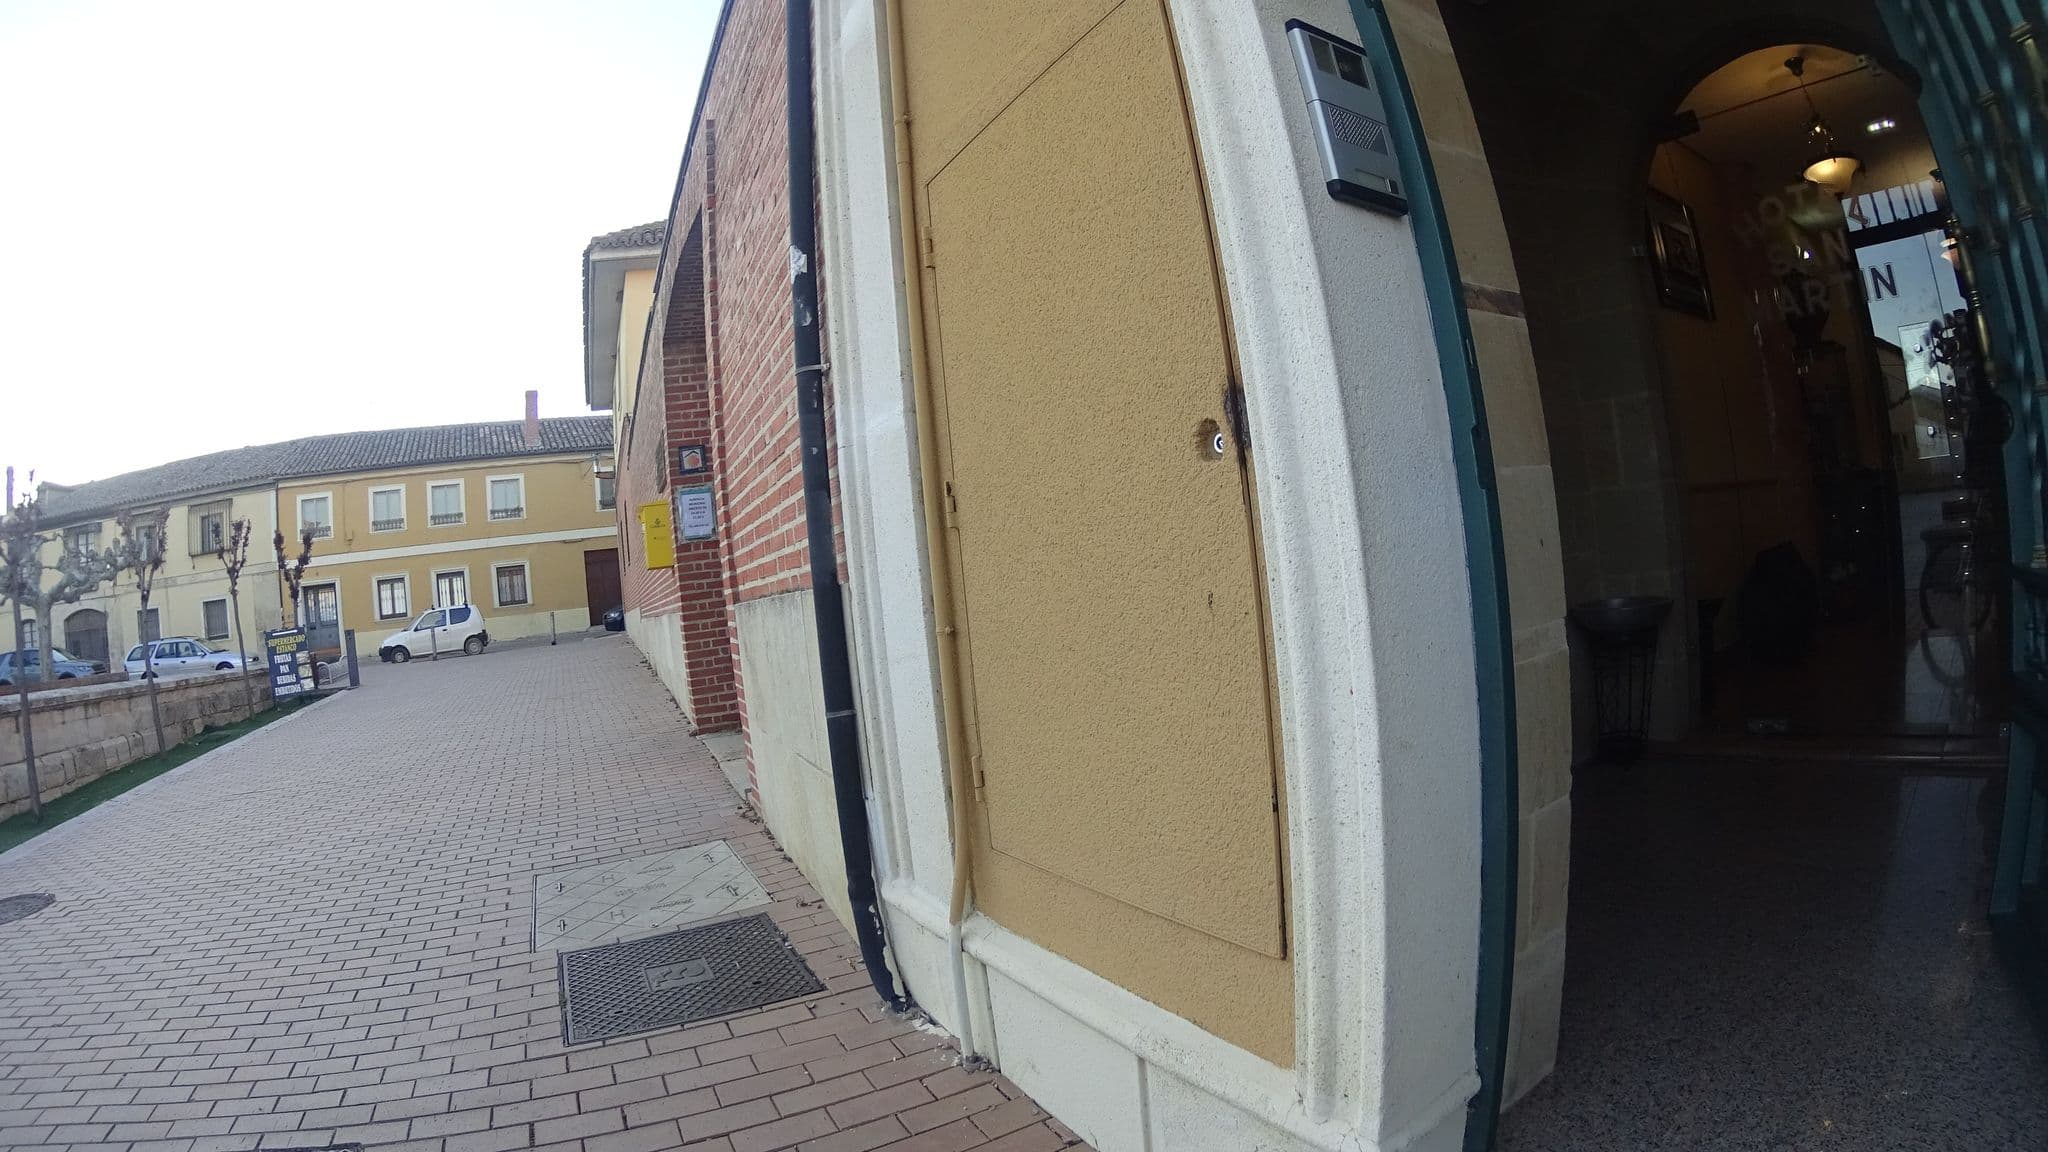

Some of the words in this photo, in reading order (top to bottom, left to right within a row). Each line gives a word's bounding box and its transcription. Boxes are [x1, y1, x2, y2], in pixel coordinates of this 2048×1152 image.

[267, 634, 306, 647] SUPERMERCADO
[276, 643, 297, 653] ESTANCO
[274, 654, 292, 664] FRUTAS
[279, 664, 290, 673] PAN
[276, 673, 297, 684] BEBIDAS
[275, 684, 302, 696] EMBUTIDOS
